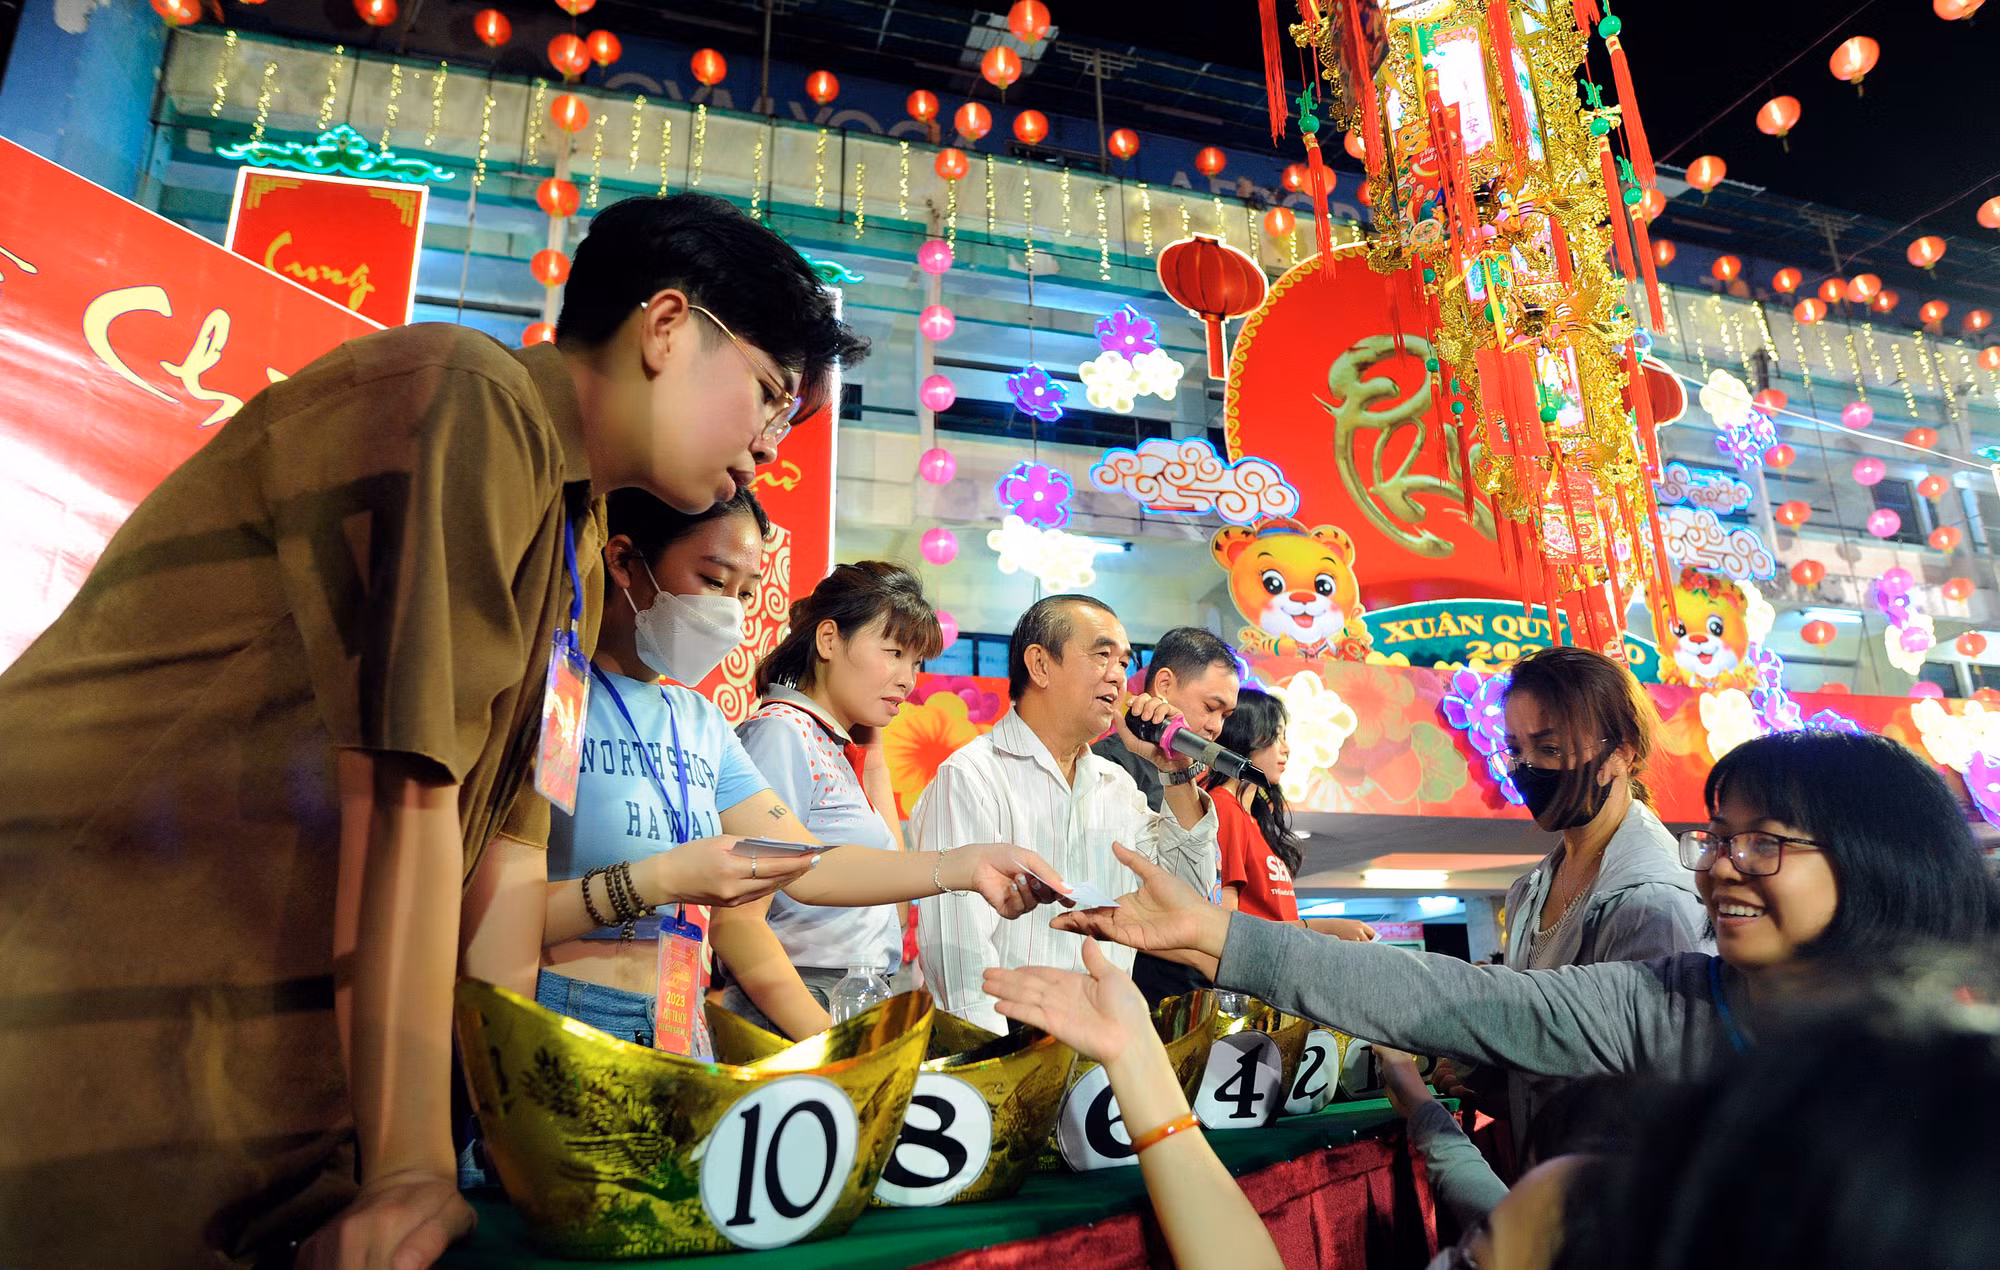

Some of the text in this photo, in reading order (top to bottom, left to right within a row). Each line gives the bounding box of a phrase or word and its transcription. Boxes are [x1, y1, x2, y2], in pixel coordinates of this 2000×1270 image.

[1380, 611, 1485, 644] XUÂN
[665, 991, 687, 1008] 2023
[1213, 1042, 1266, 1119] 4
[1292, 1045, 1329, 1101] 2
[726, 1100, 838, 1227] 10
[880, 1095, 968, 1188] 8
